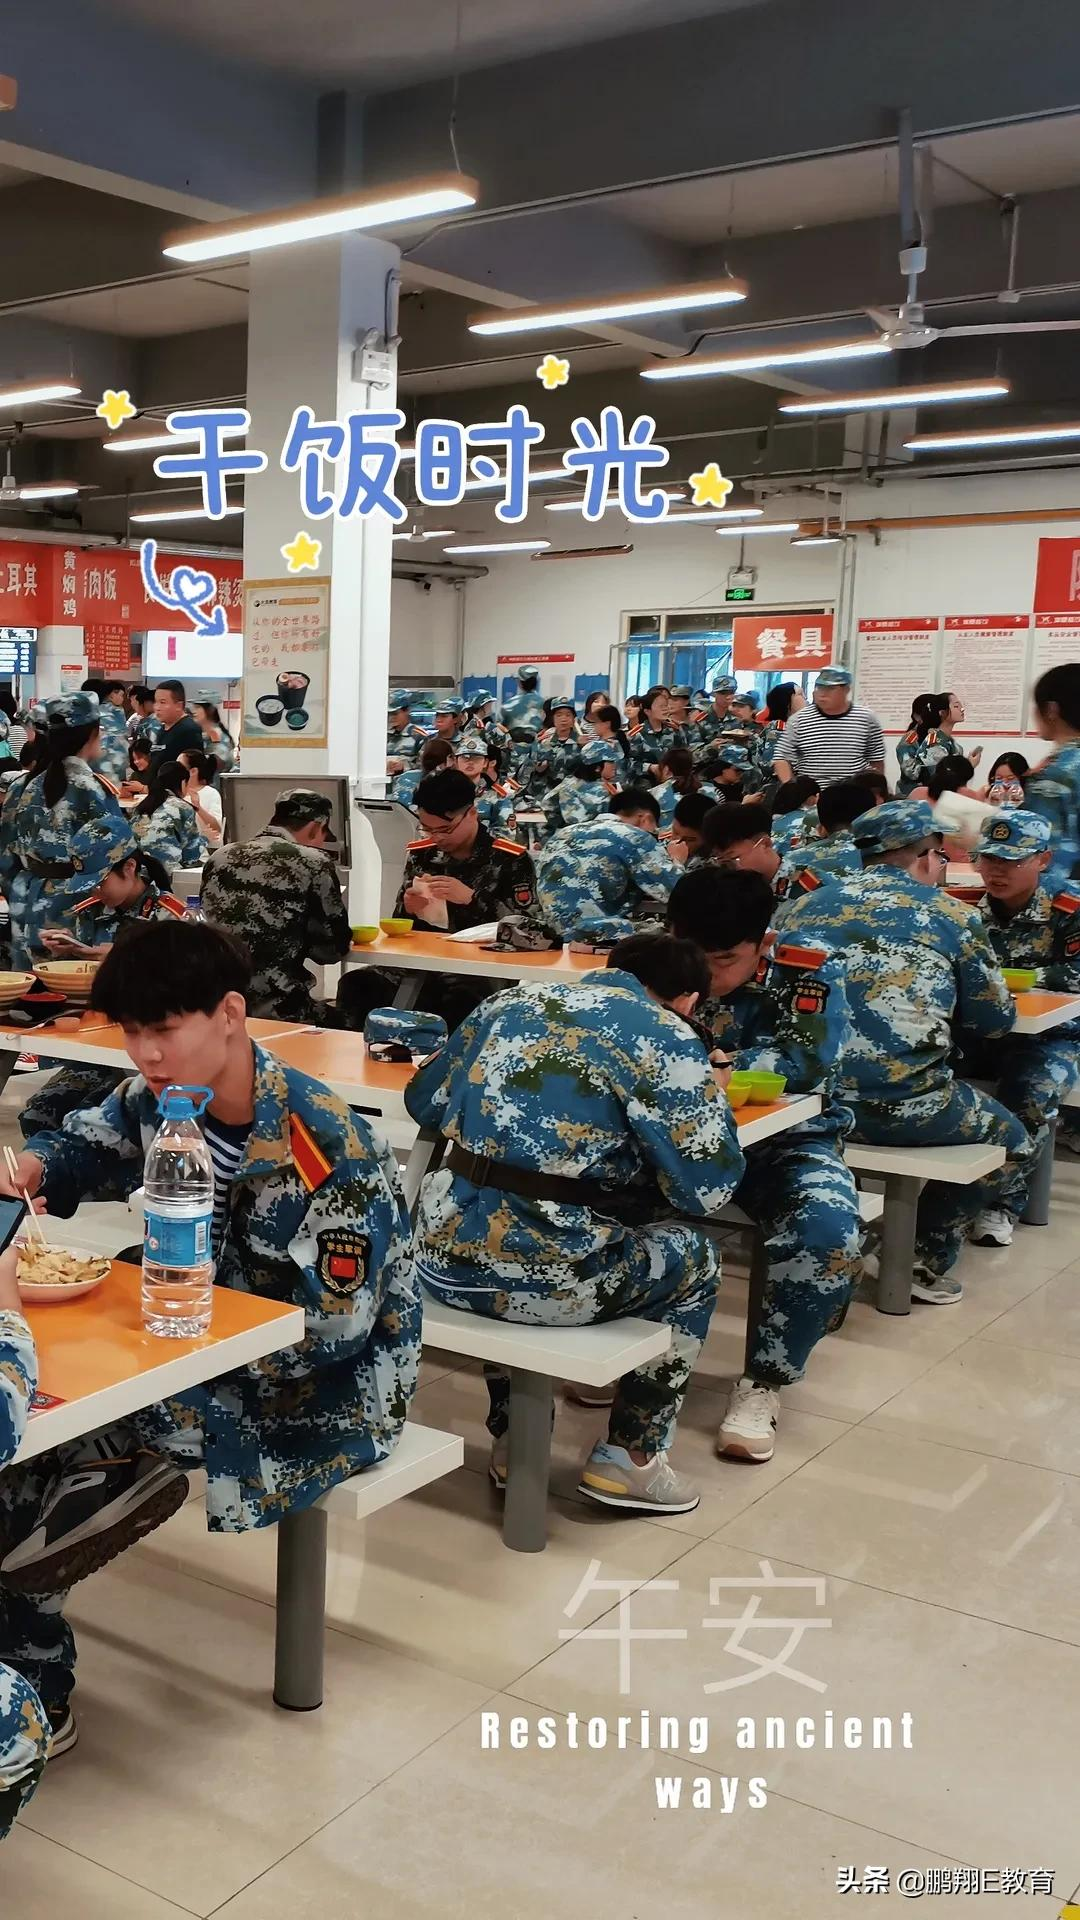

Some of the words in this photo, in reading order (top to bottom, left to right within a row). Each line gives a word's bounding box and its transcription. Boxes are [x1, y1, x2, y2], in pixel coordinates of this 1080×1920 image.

[0, 562, 37, 597] 耳其
[62, 550, 77, 618] 黄焖鸡
[756, 627, 827, 659] 餐具
